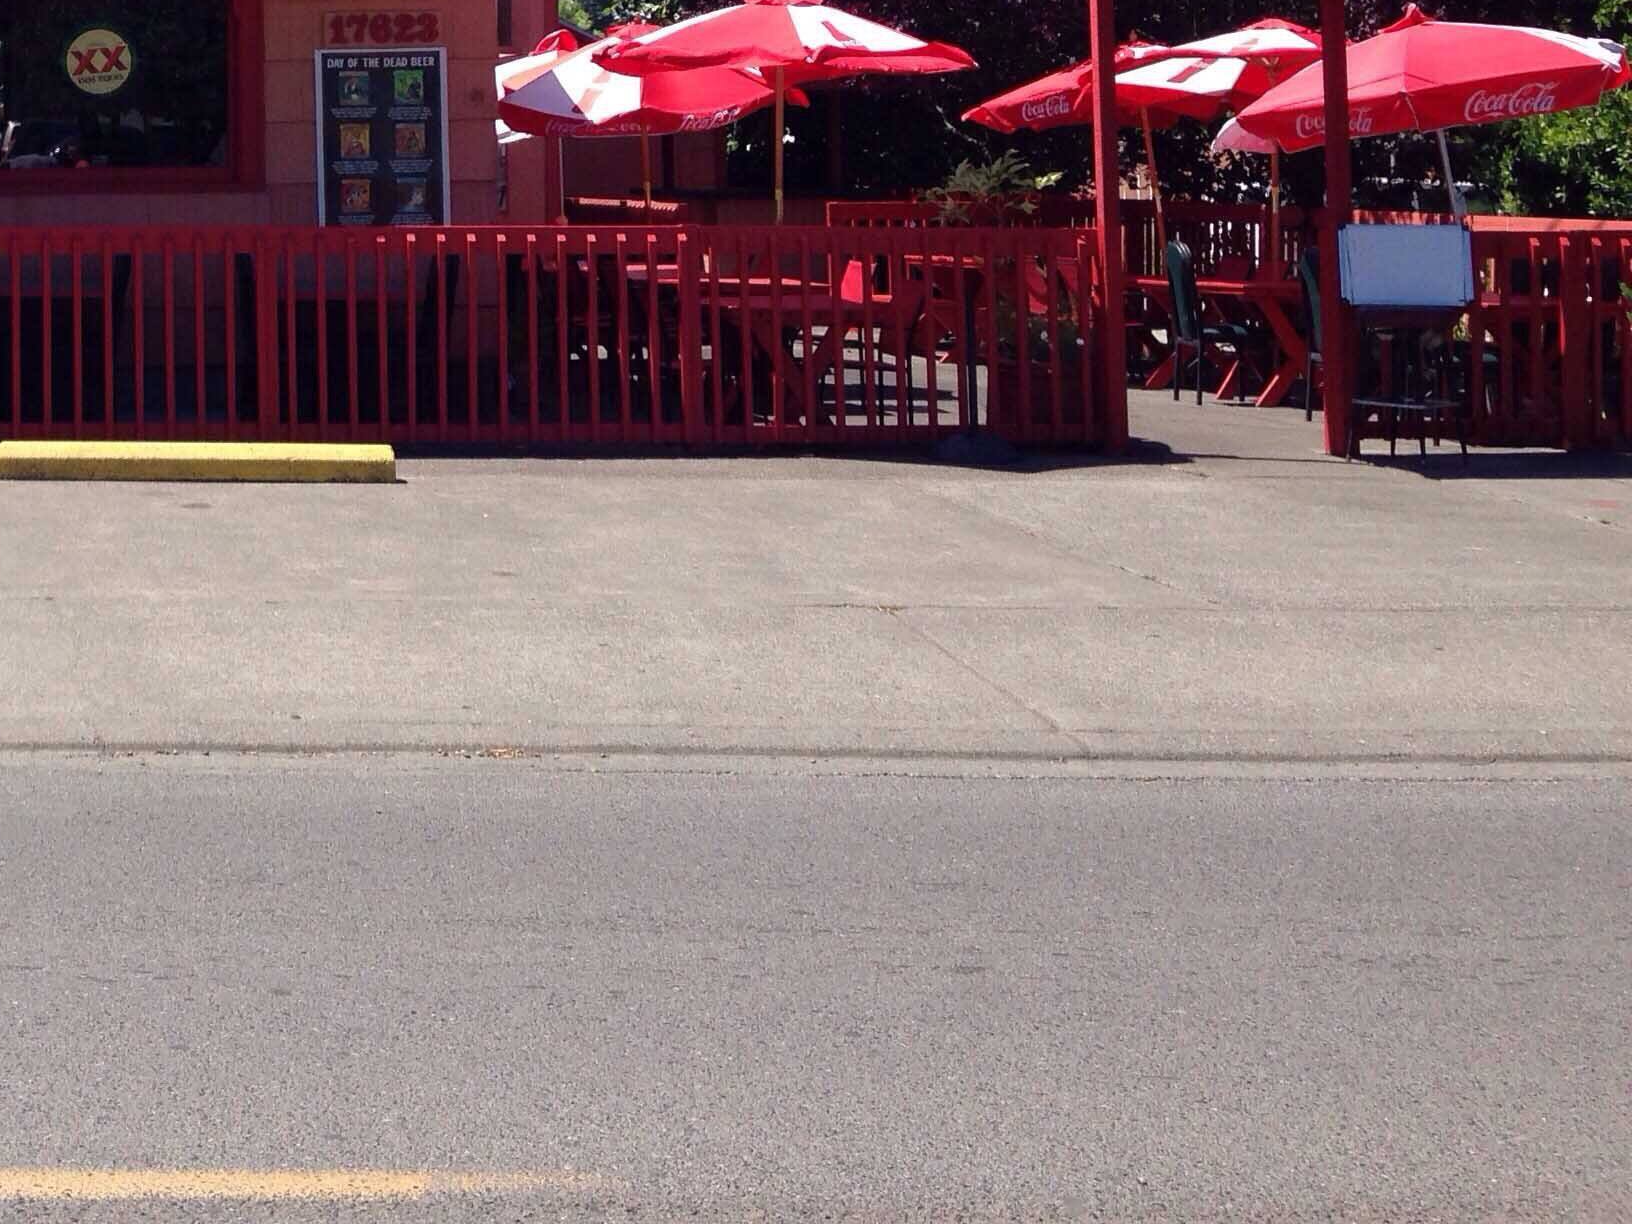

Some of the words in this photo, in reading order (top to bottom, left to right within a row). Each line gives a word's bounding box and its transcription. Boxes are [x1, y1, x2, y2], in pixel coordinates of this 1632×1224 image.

[329, 13, 440, 44] 17623
[70, 44, 129, 76] XX
[327, 58, 344, 69] DAY
[347, 57, 359, 68] OF
[362, 57, 381, 67] THE
[383, 56, 408, 67] DEAD
[411, 56, 435, 67] BEER
[1463, 80, 1561, 122] Coca-Cola
